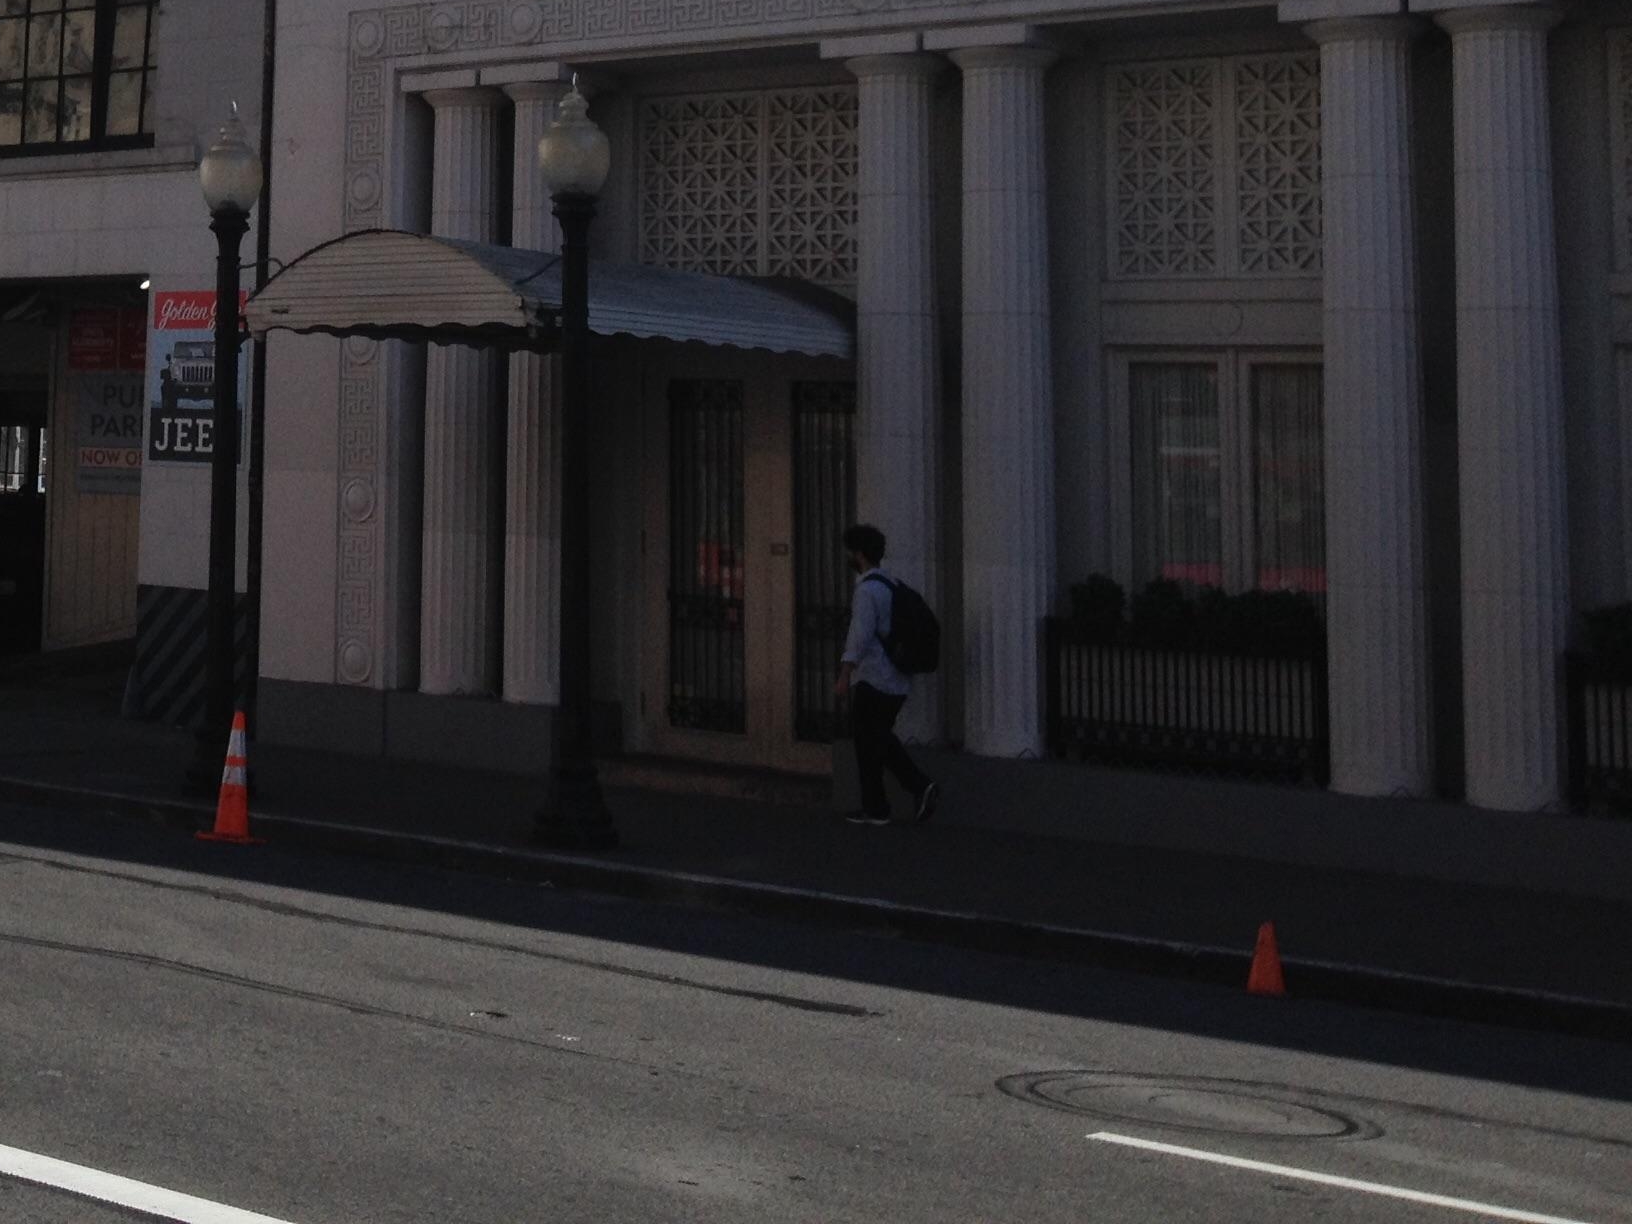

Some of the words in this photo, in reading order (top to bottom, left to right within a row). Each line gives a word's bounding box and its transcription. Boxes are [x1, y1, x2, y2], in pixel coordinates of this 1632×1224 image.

[158, 298, 209, 330] Golden
[155, 417, 214, 453] JEE
[81, 450, 120, 465] NOW
